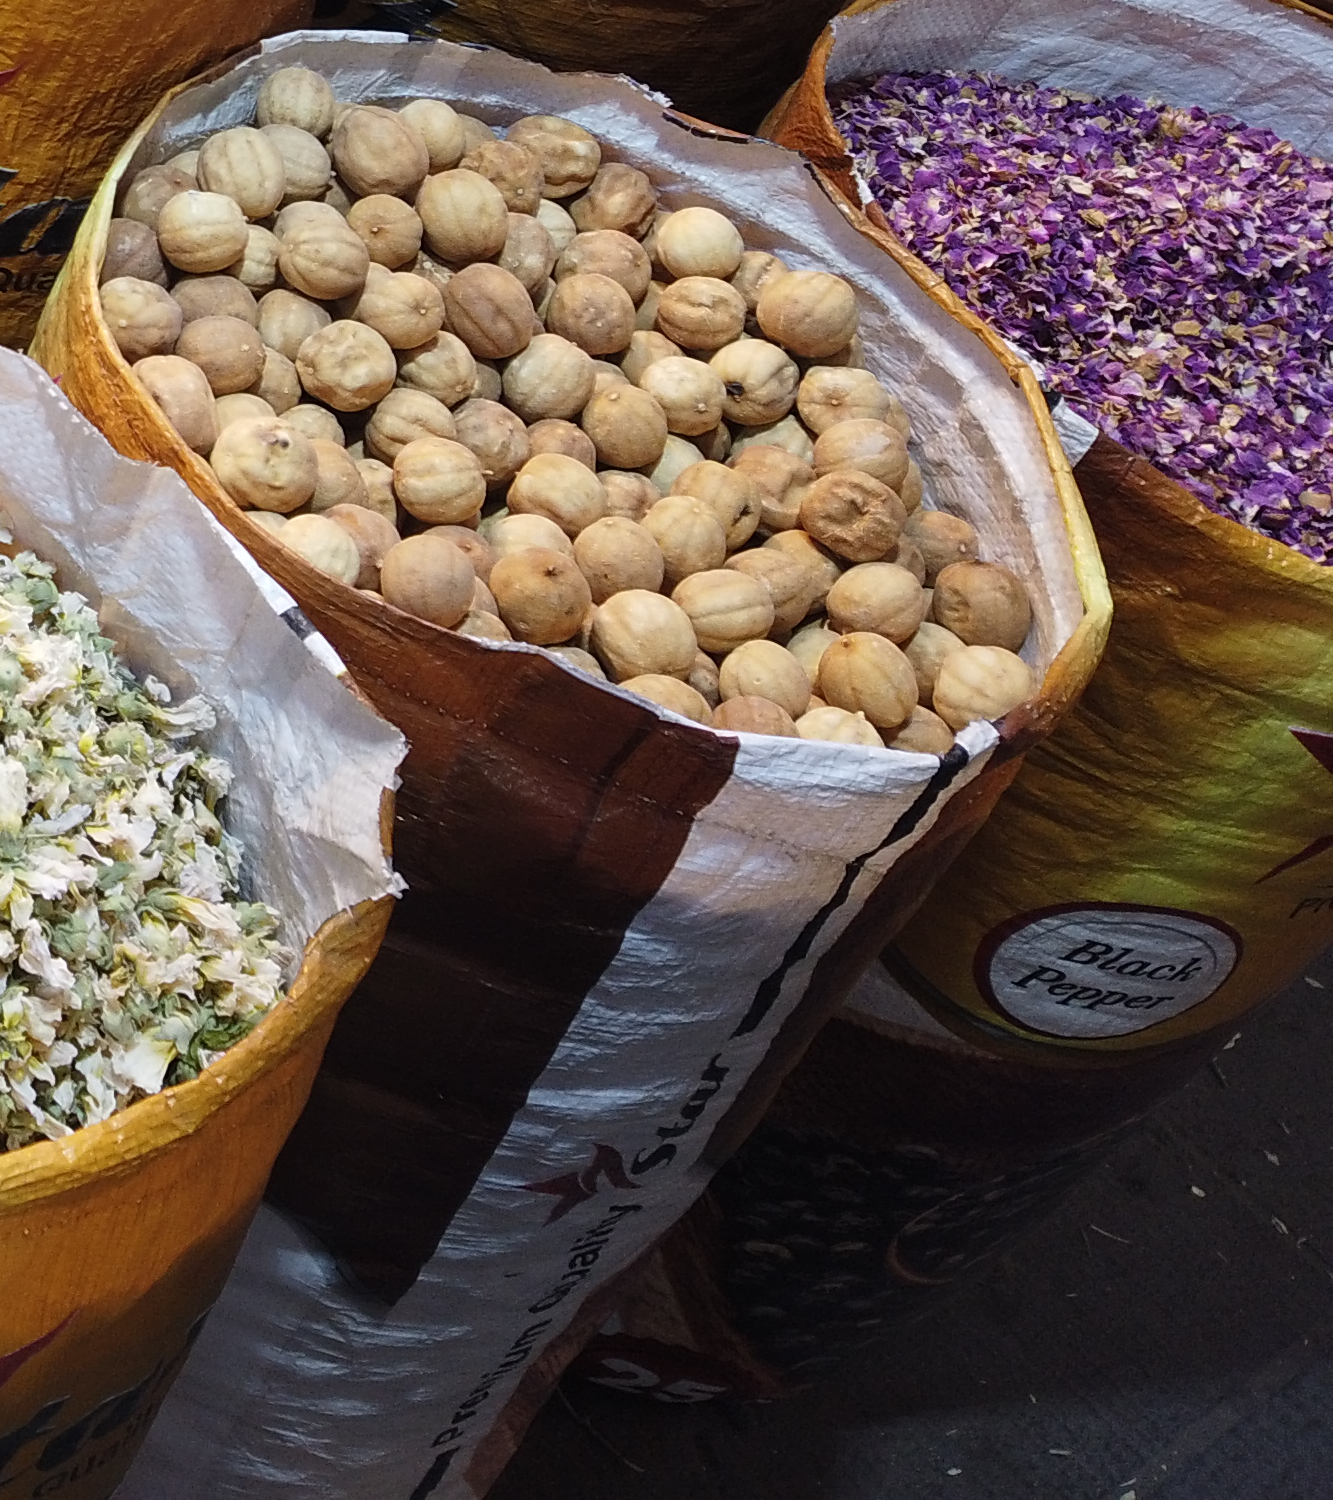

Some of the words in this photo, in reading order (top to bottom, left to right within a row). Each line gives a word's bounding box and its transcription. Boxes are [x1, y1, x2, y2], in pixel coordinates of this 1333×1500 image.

[1058, 939, 1203, 982] Black
[1010, 964, 1175, 1010] Pepper
[630, 1052, 731, 1176] Star
[528, 1203, 643, 1315] Quality
[586, 1357, 728, 1403] 25
